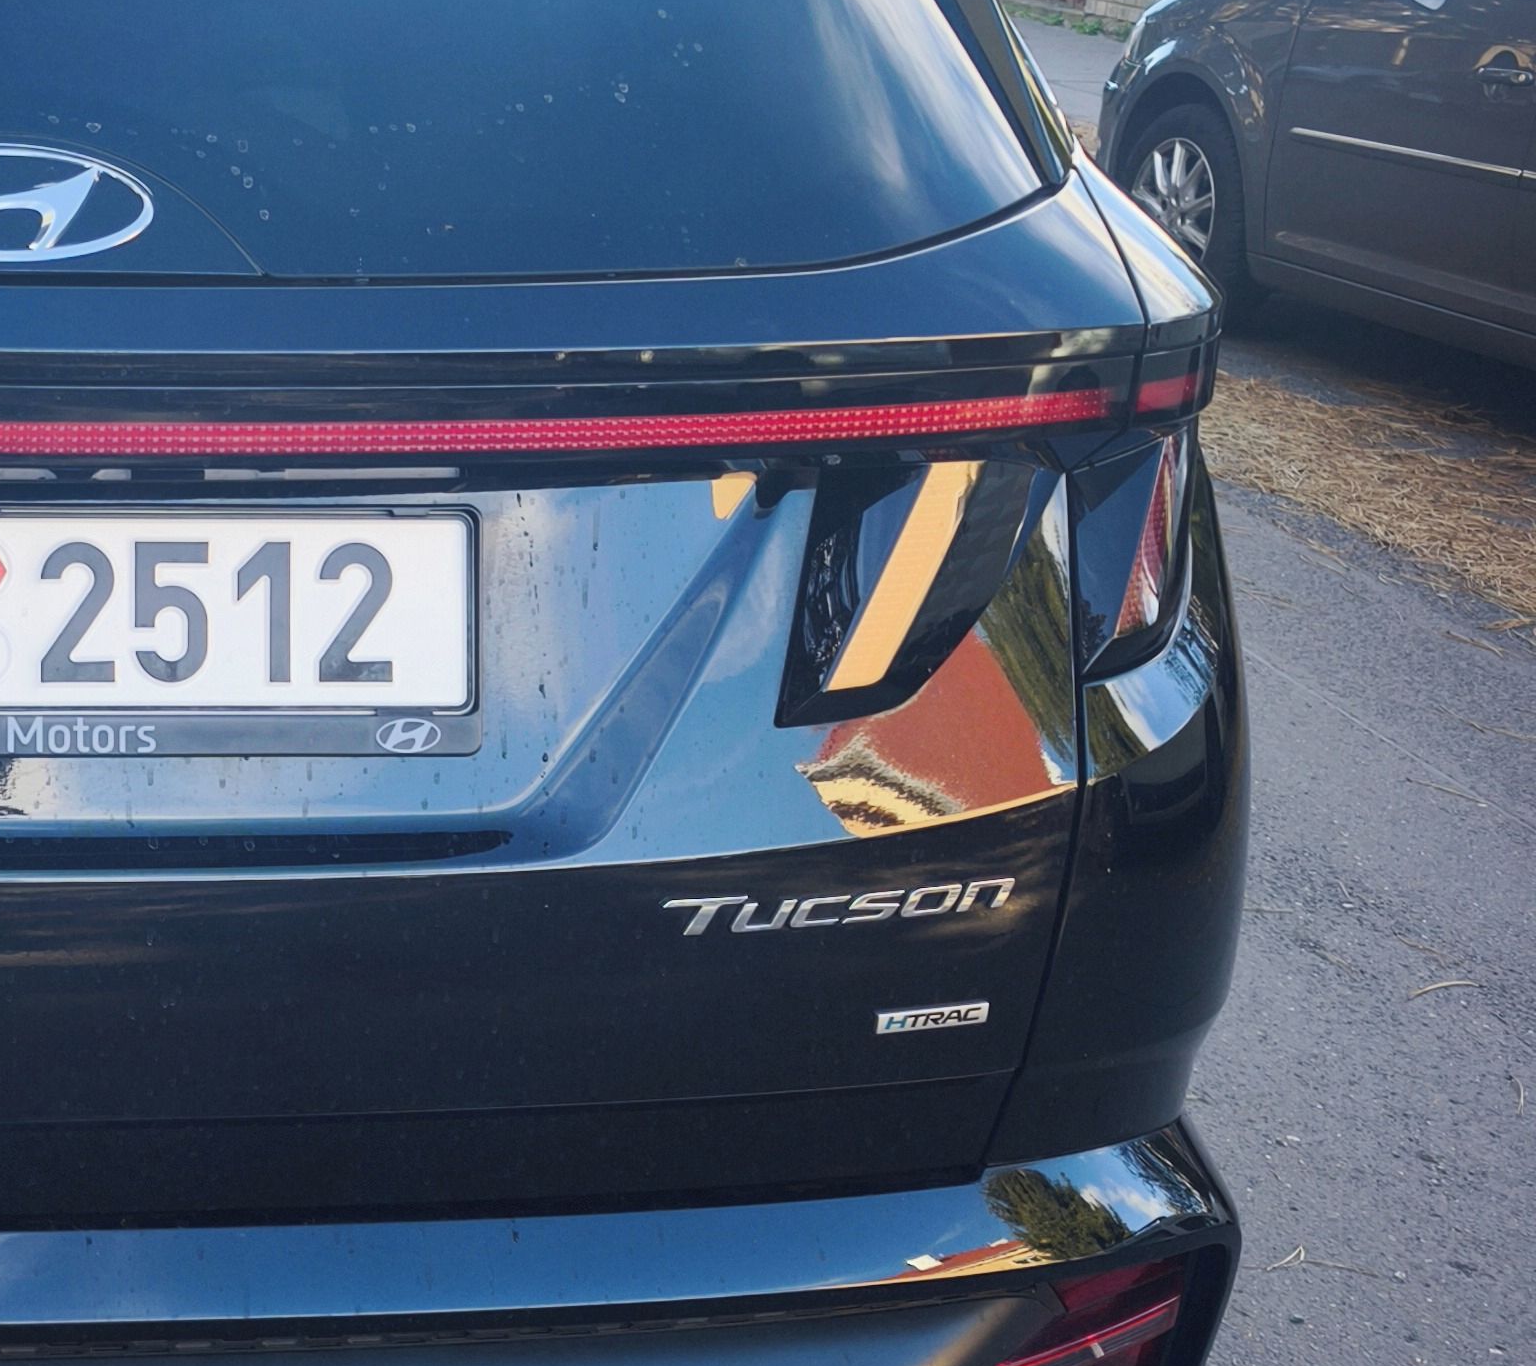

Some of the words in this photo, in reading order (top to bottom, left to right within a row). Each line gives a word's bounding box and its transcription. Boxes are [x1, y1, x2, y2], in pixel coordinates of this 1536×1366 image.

[40, 541, 393, 682] 2512
[8, 716, 157, 755] Motors
[663, 877, 1015, 935] TUCSON
[884, 1006, 982, 1030] HTRAC
